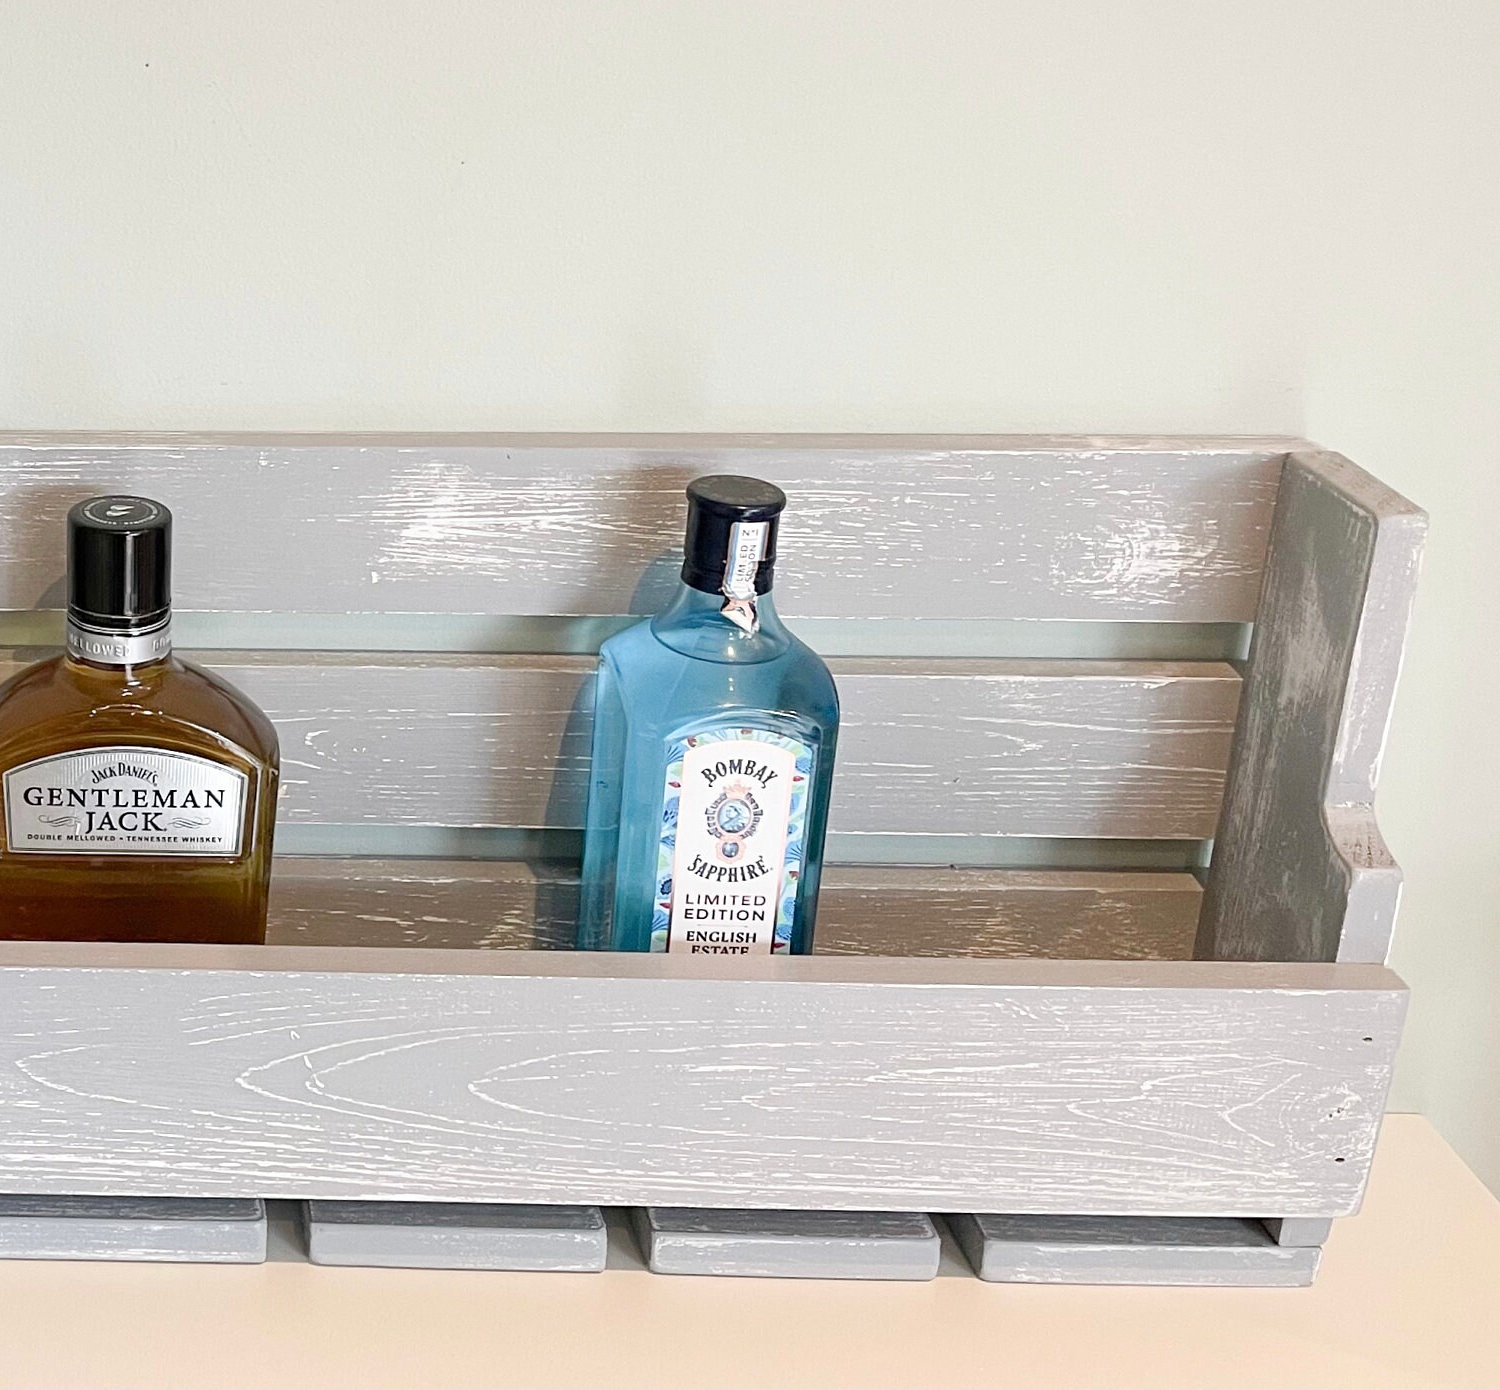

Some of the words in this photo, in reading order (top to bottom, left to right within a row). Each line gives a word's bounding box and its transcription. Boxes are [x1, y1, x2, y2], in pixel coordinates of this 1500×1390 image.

[91, 766, 117, 784] JACK
[701, 758, 778, 789] BOMBAY
[23, 787, 226, 808] GENTLEMAN
[85, 811, 164, 835] JACK
[182, 836, 223, 844] WHISKEY
[687, 854, 770, 883] SAPPHIRE
[685, 894, 766, 906] LIMITED
[684, 908, 765, 921] EDITION
[686, 930, 757, 943] ENGLISH
